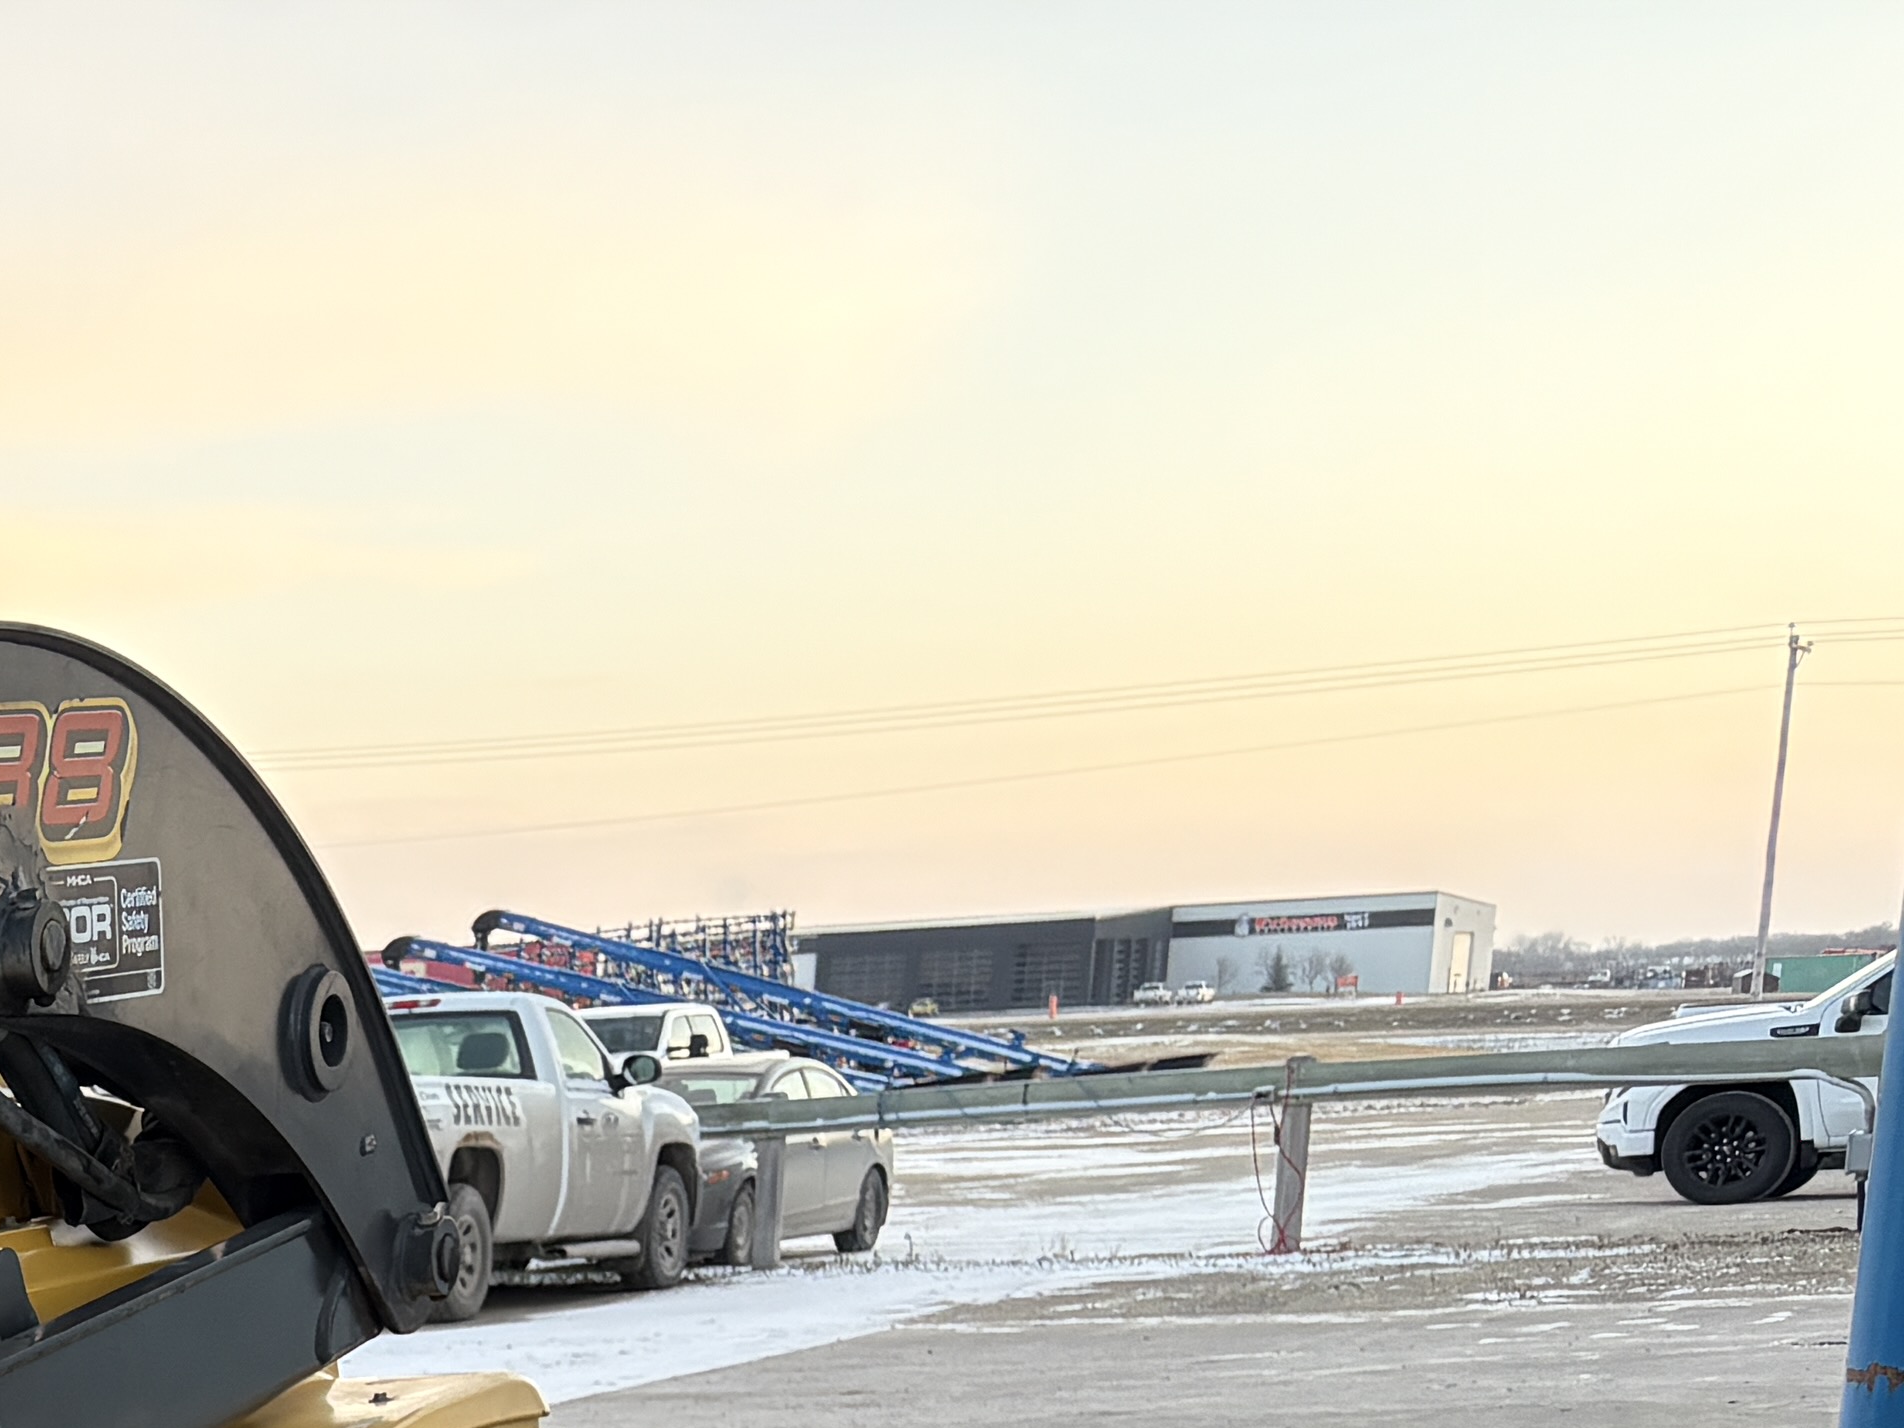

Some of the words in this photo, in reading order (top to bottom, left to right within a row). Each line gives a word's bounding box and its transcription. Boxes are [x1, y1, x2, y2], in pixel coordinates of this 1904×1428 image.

[120, 885, 157, 908] Certified
[63, 903, 112, 943] OR
[121, 910, 149, 933] Safety
[122, 934, 159, 956] Program
[445, 1083, 521, 1127] SERVICE
